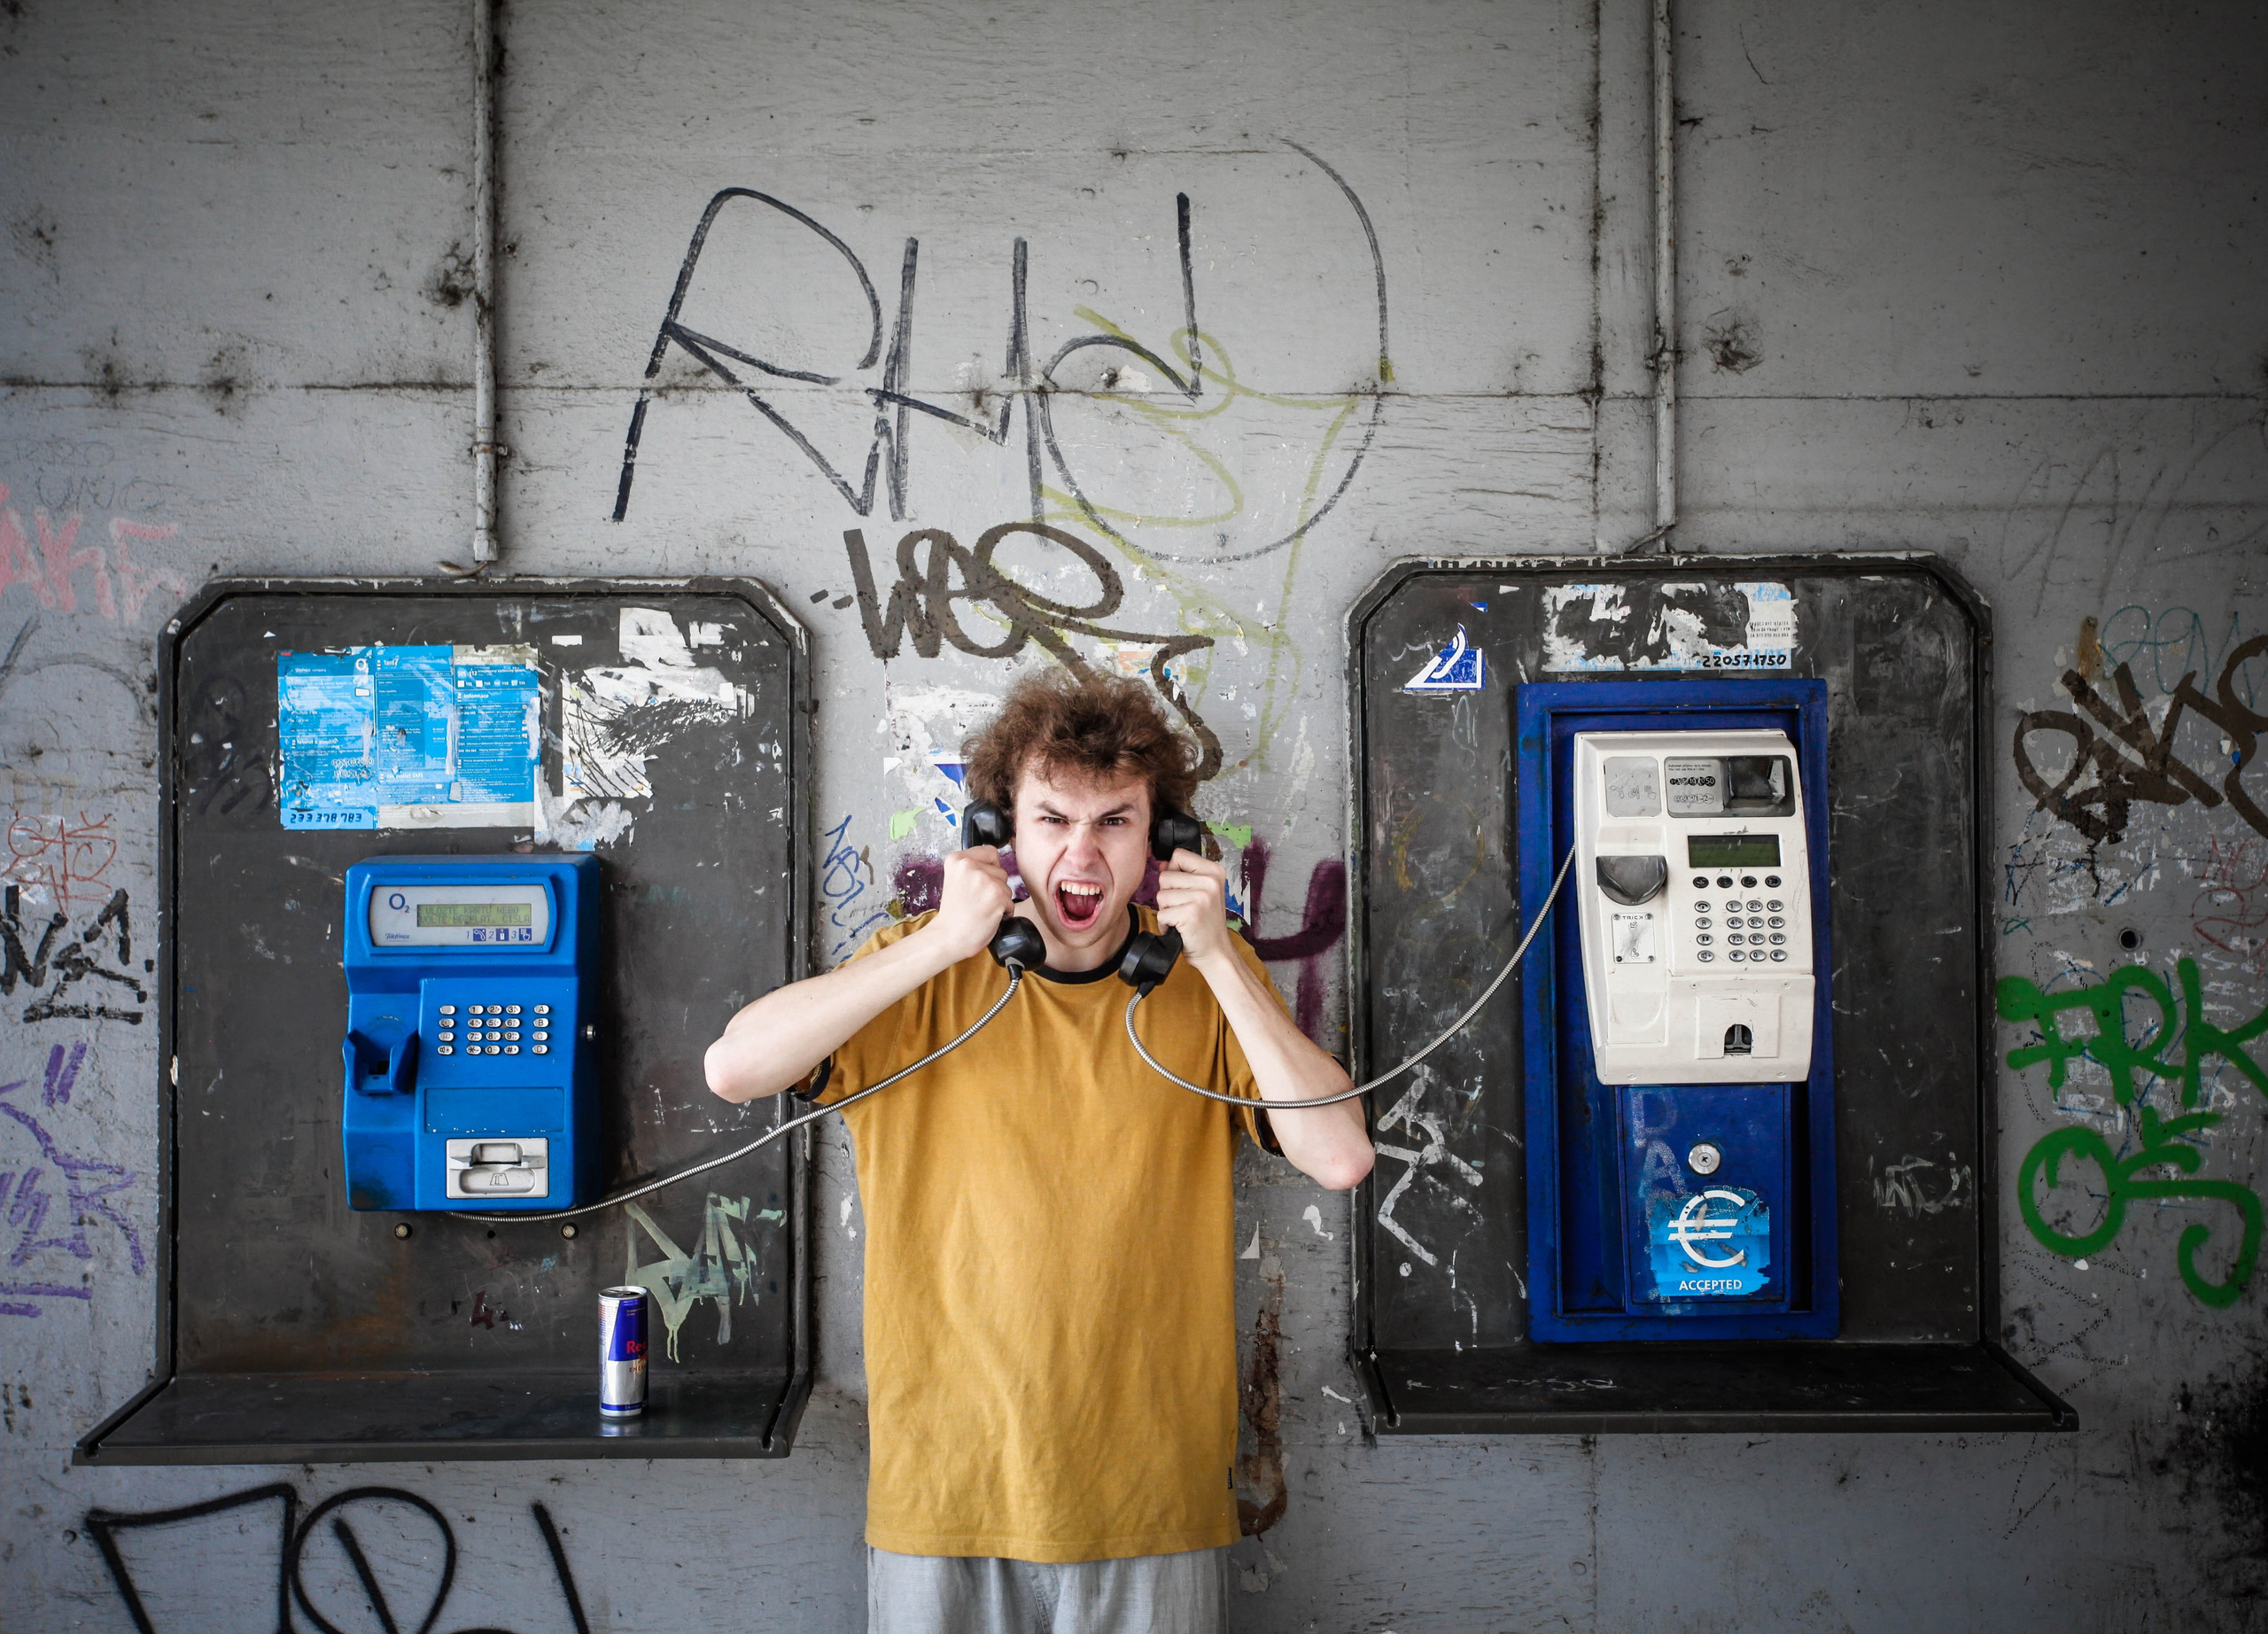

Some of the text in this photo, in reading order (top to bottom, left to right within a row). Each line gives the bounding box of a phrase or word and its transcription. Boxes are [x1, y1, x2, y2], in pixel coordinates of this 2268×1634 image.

[1703, 654, 1786, 667] 220571750
[291, 813, 313, 824] 233
[1679, 1280, 1742, 1290] ACCEPTED
